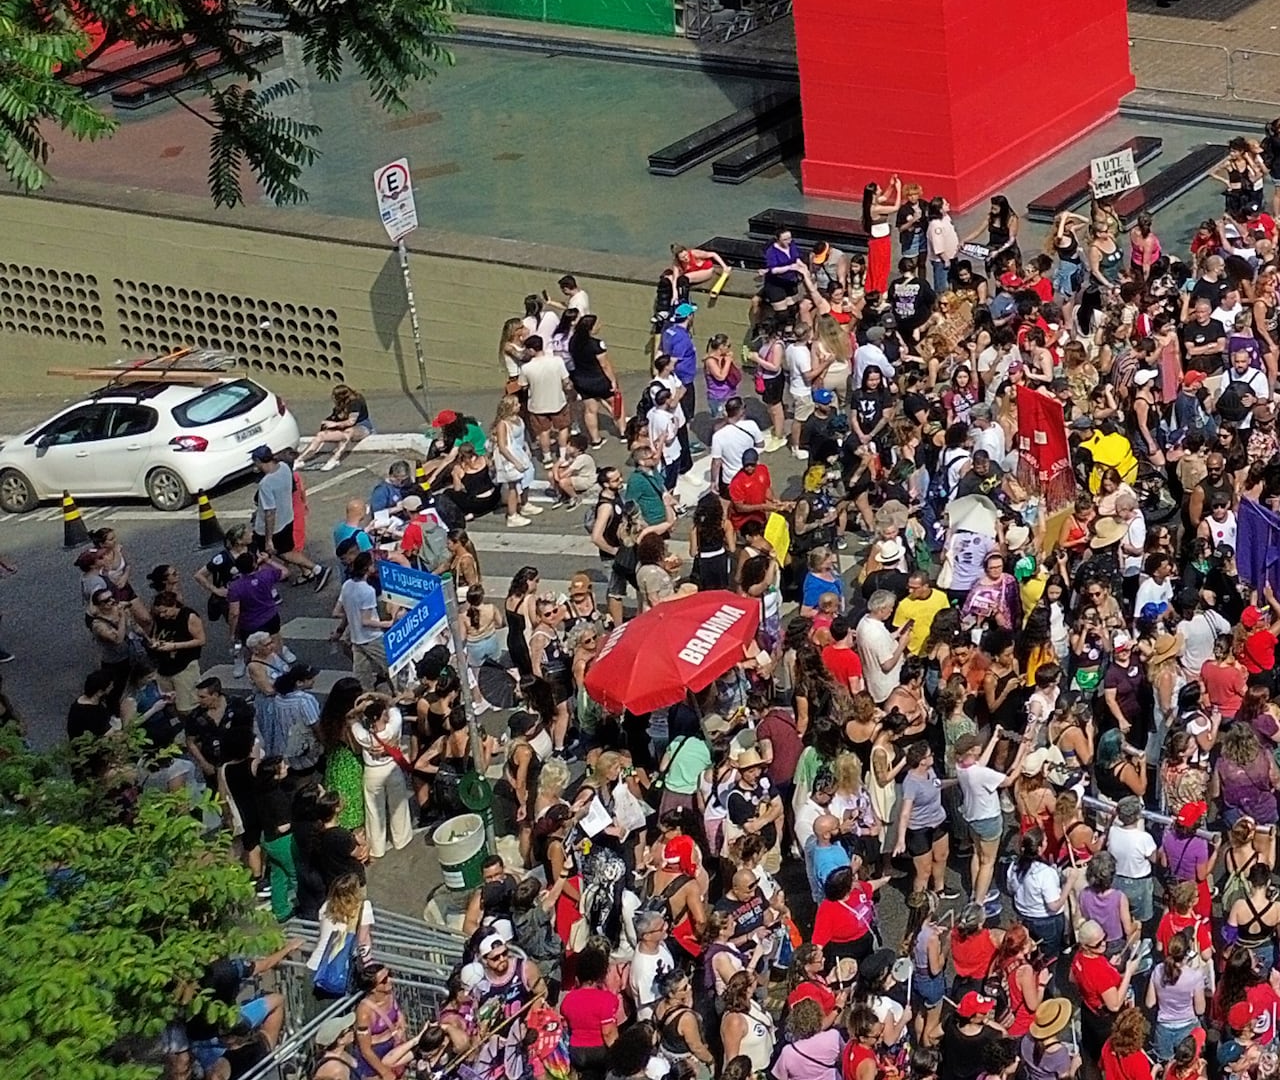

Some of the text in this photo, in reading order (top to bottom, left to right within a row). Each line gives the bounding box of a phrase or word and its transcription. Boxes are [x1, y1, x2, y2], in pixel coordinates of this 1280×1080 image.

[386, 171, 399, 193] E
[387, 604, 430, 650] Paulista
[677, 603, 747, 666] BRAHMA
